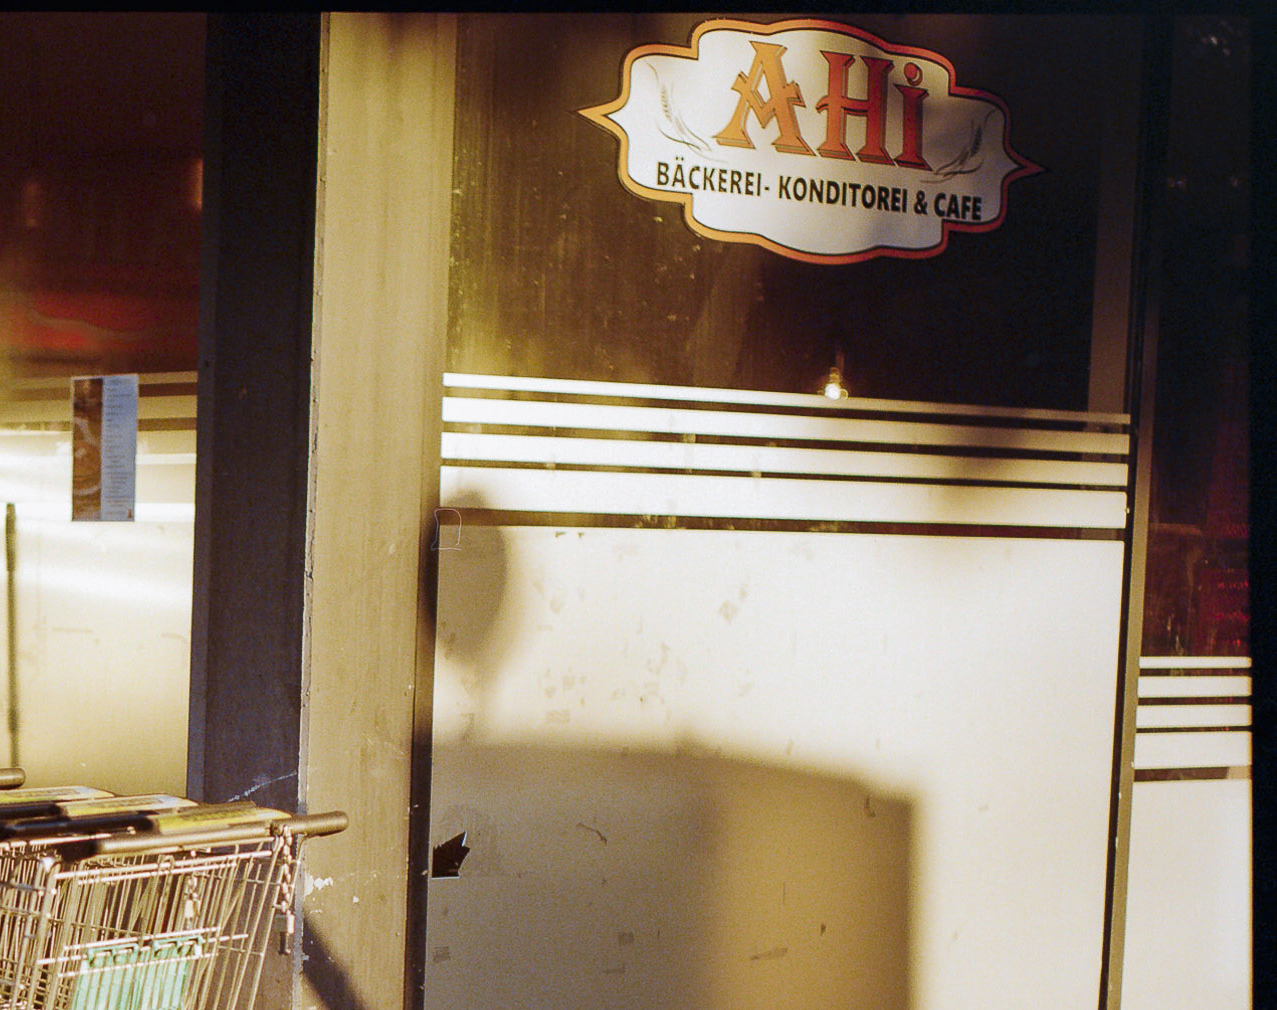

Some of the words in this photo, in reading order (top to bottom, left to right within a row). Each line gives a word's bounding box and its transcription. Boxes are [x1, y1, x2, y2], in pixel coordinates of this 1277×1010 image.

[656, 156, 771, 197] BÄCKEREI-
[778, 175, 909, 214] KONDITOREI
[914, 190, 929, 216] &
[933, 192, 983, 221] CAFE
